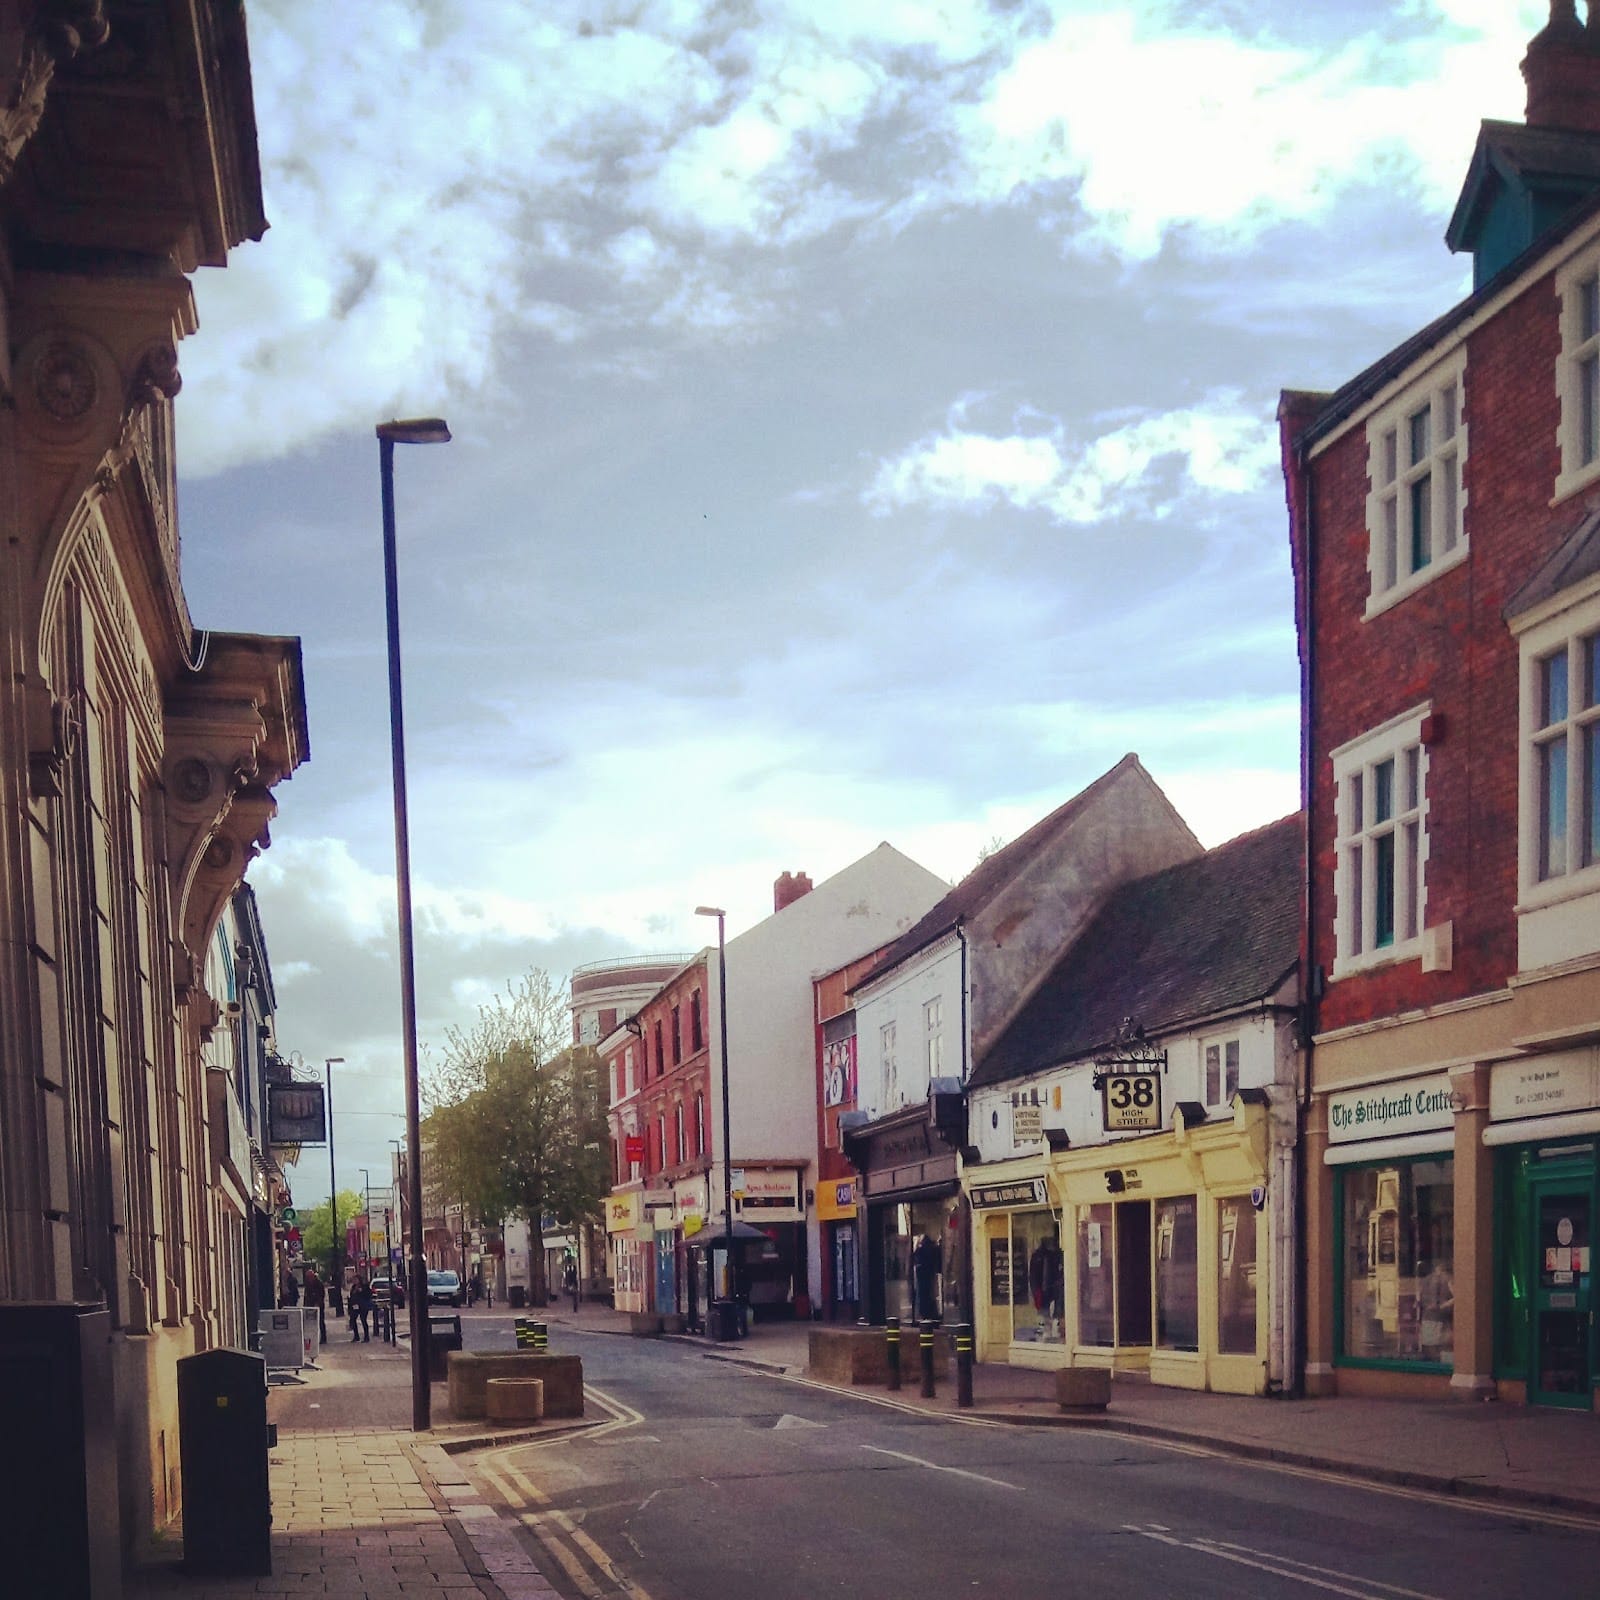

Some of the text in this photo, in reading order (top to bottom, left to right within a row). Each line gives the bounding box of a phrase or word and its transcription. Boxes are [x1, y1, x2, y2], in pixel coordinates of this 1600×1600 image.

[1111, 1078, 1153, 1109] 38
[1122, 1109, 1143, 1117] HIGH
[1332, 1103, 1353, 1130] The
[1355, 1093, 1413, 1124] Stitchcraft
[1116, 1118, 1149, 1126] STREET
